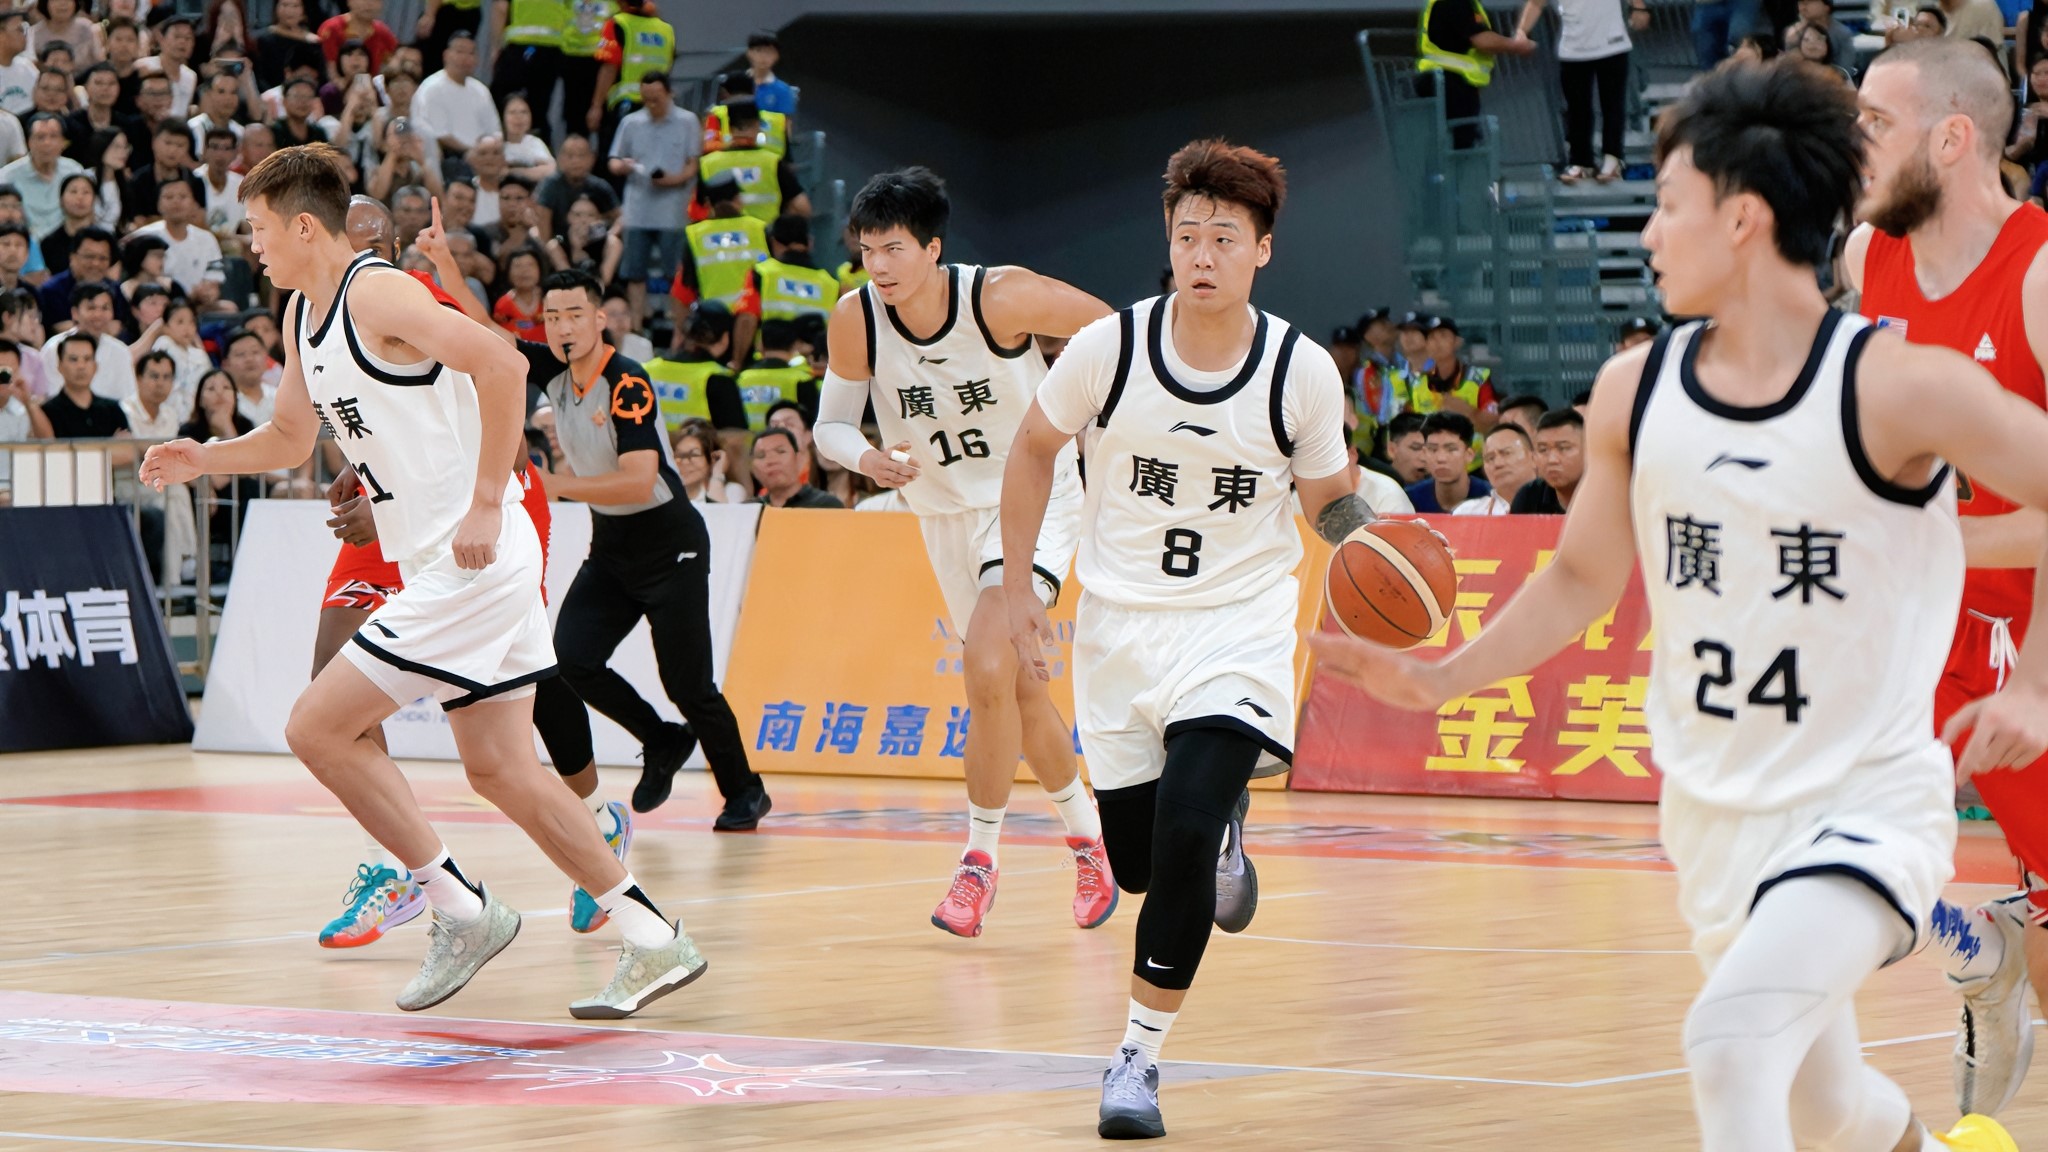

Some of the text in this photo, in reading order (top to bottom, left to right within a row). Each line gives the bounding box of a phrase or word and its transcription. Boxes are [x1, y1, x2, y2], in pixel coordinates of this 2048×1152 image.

[896, 378, 998, 420] 廣東
[929, 428, 991, 467] 16
[1129, 455, 1264, 514] 廣東
[1161, 528, 1202, 578] 8
[1665, 512, 1848, 606] 廣東
[0, 587, 138, 671] 体育
[1693, 638, 1812, 724] 24
